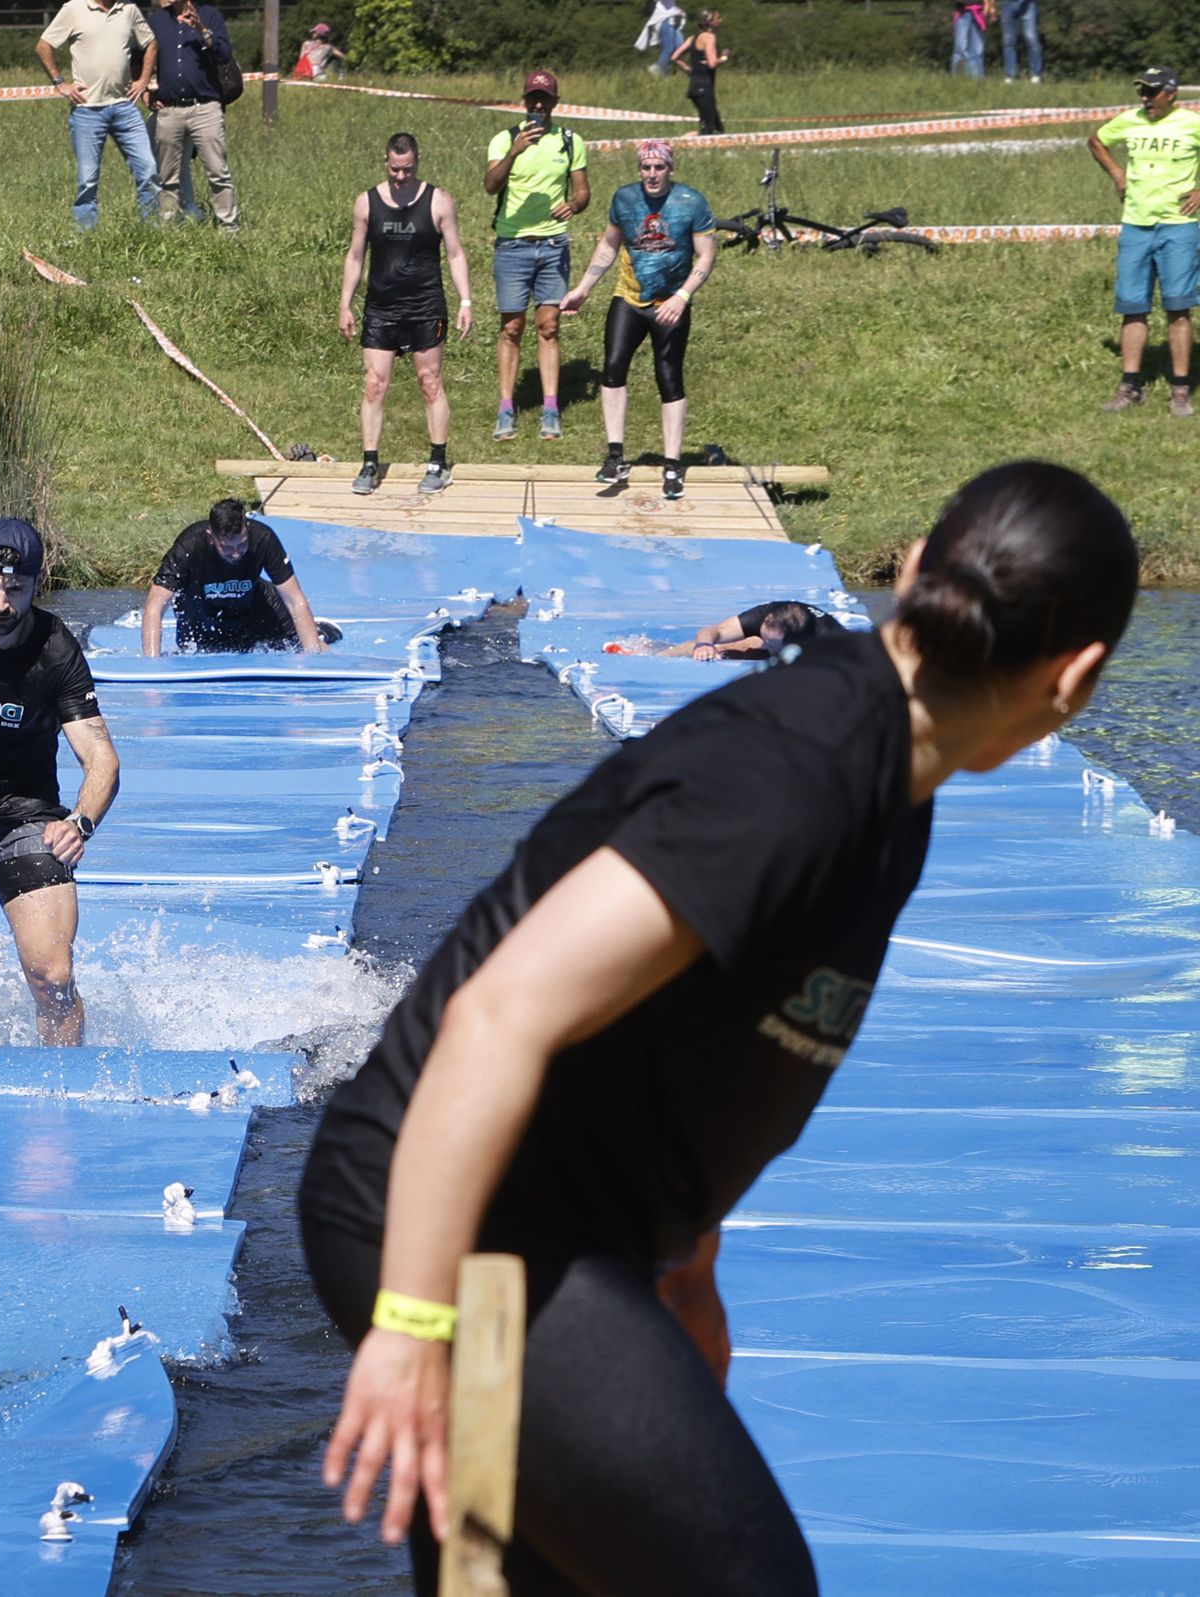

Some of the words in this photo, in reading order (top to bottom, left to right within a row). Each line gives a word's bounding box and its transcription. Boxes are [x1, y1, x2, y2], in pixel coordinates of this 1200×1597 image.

[1126, 137, 1181, 152] STAFF
[382, 221, 417, 234] FILA
[0, 721, 21, 729] BOX
